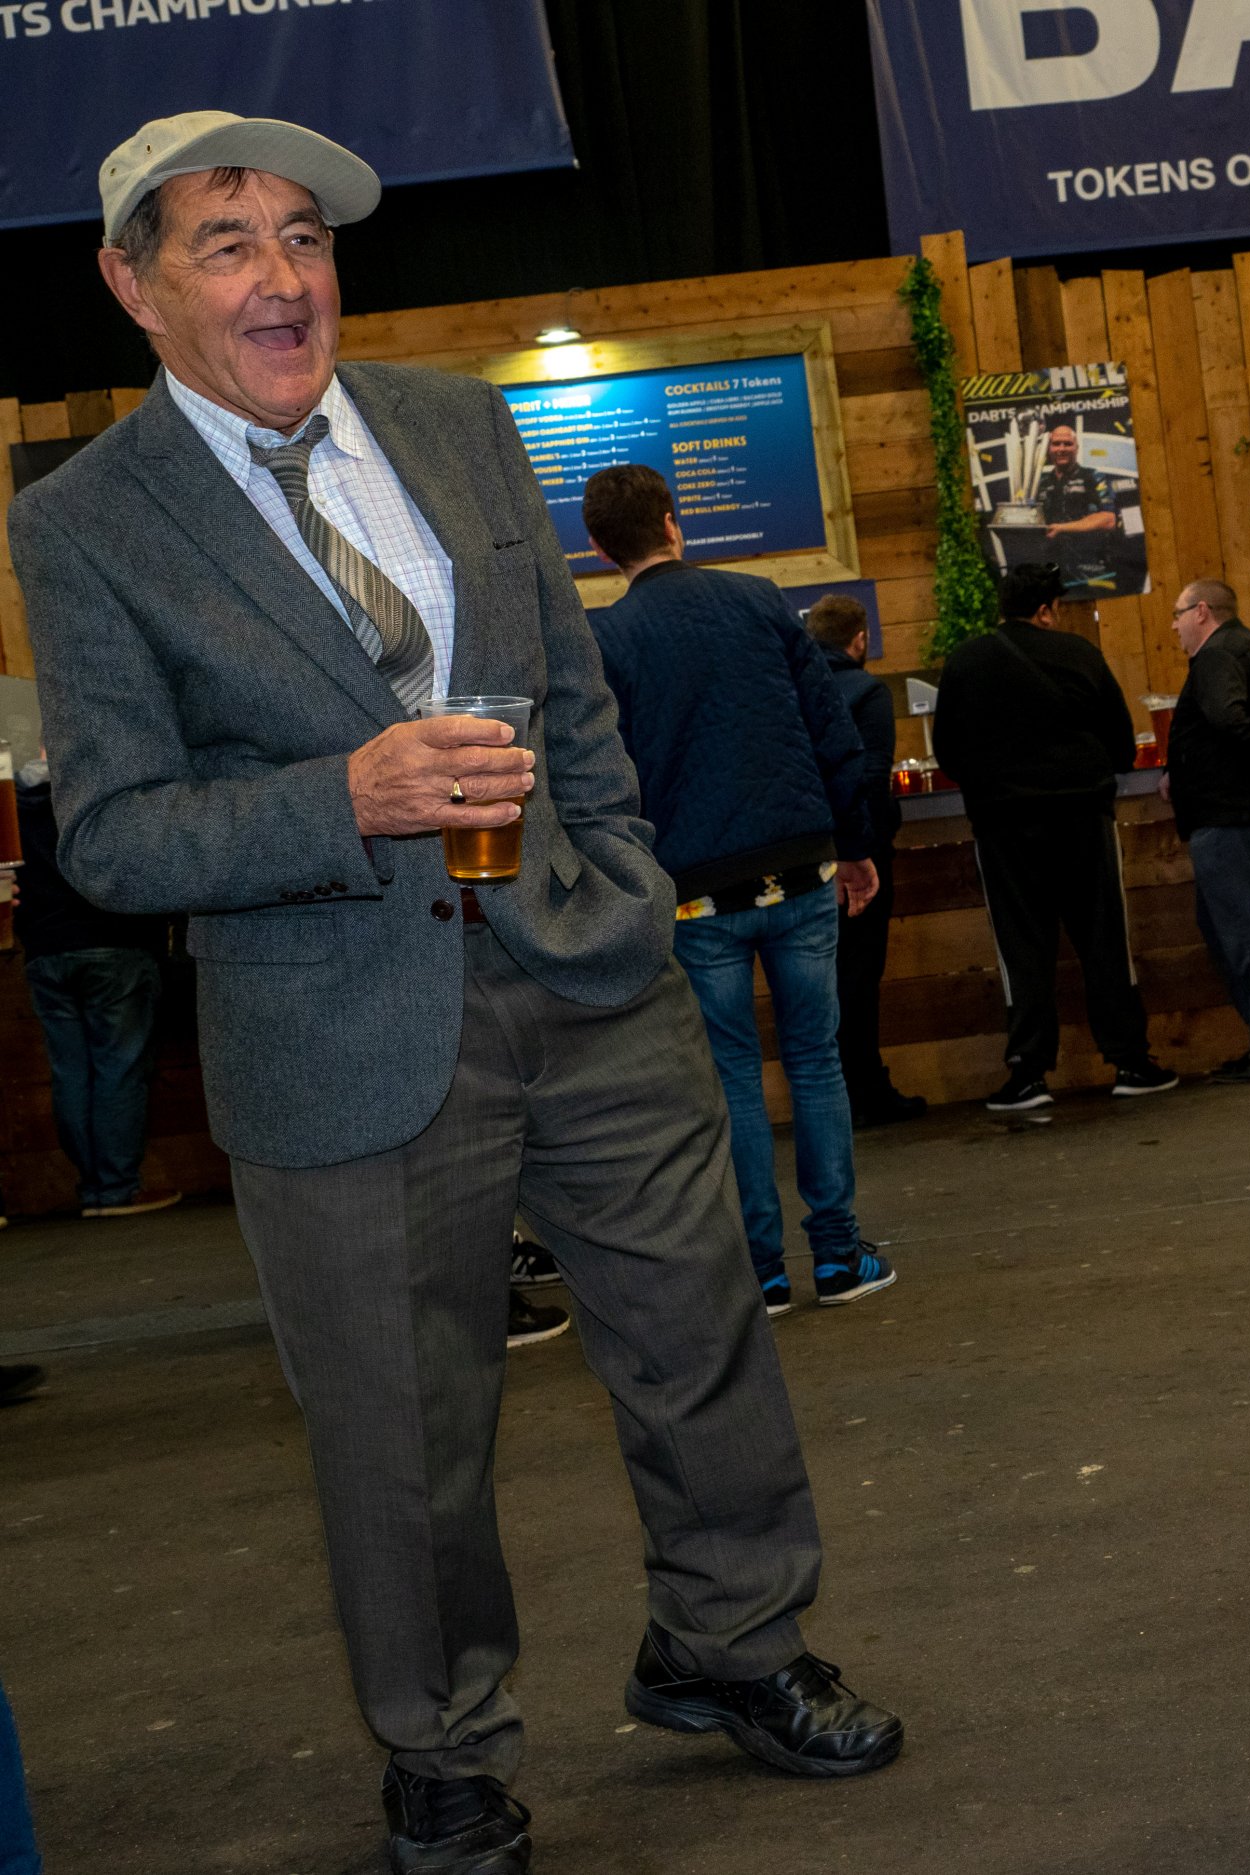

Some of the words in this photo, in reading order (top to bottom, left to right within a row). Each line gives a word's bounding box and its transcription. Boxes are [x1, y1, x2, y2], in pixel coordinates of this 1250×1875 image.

[1047, 157, 1217, 202] TOKENS
[665, 380, 731, 397] COCKTAILS
[732, 378, 740, 389] 7
[742, 377, 782, 388] Tokens
[509, 400, 541, 413] PIRIT
[967, 407, 1017, 424] DARTS
[672, 440, 700, 454] SOFT
[703, 435, 747, 450] DRINKS
[674, 457, 697, 466] WATER
[675, 469, 697, 478] COCA
[697, 467, 717, 476] COLA
